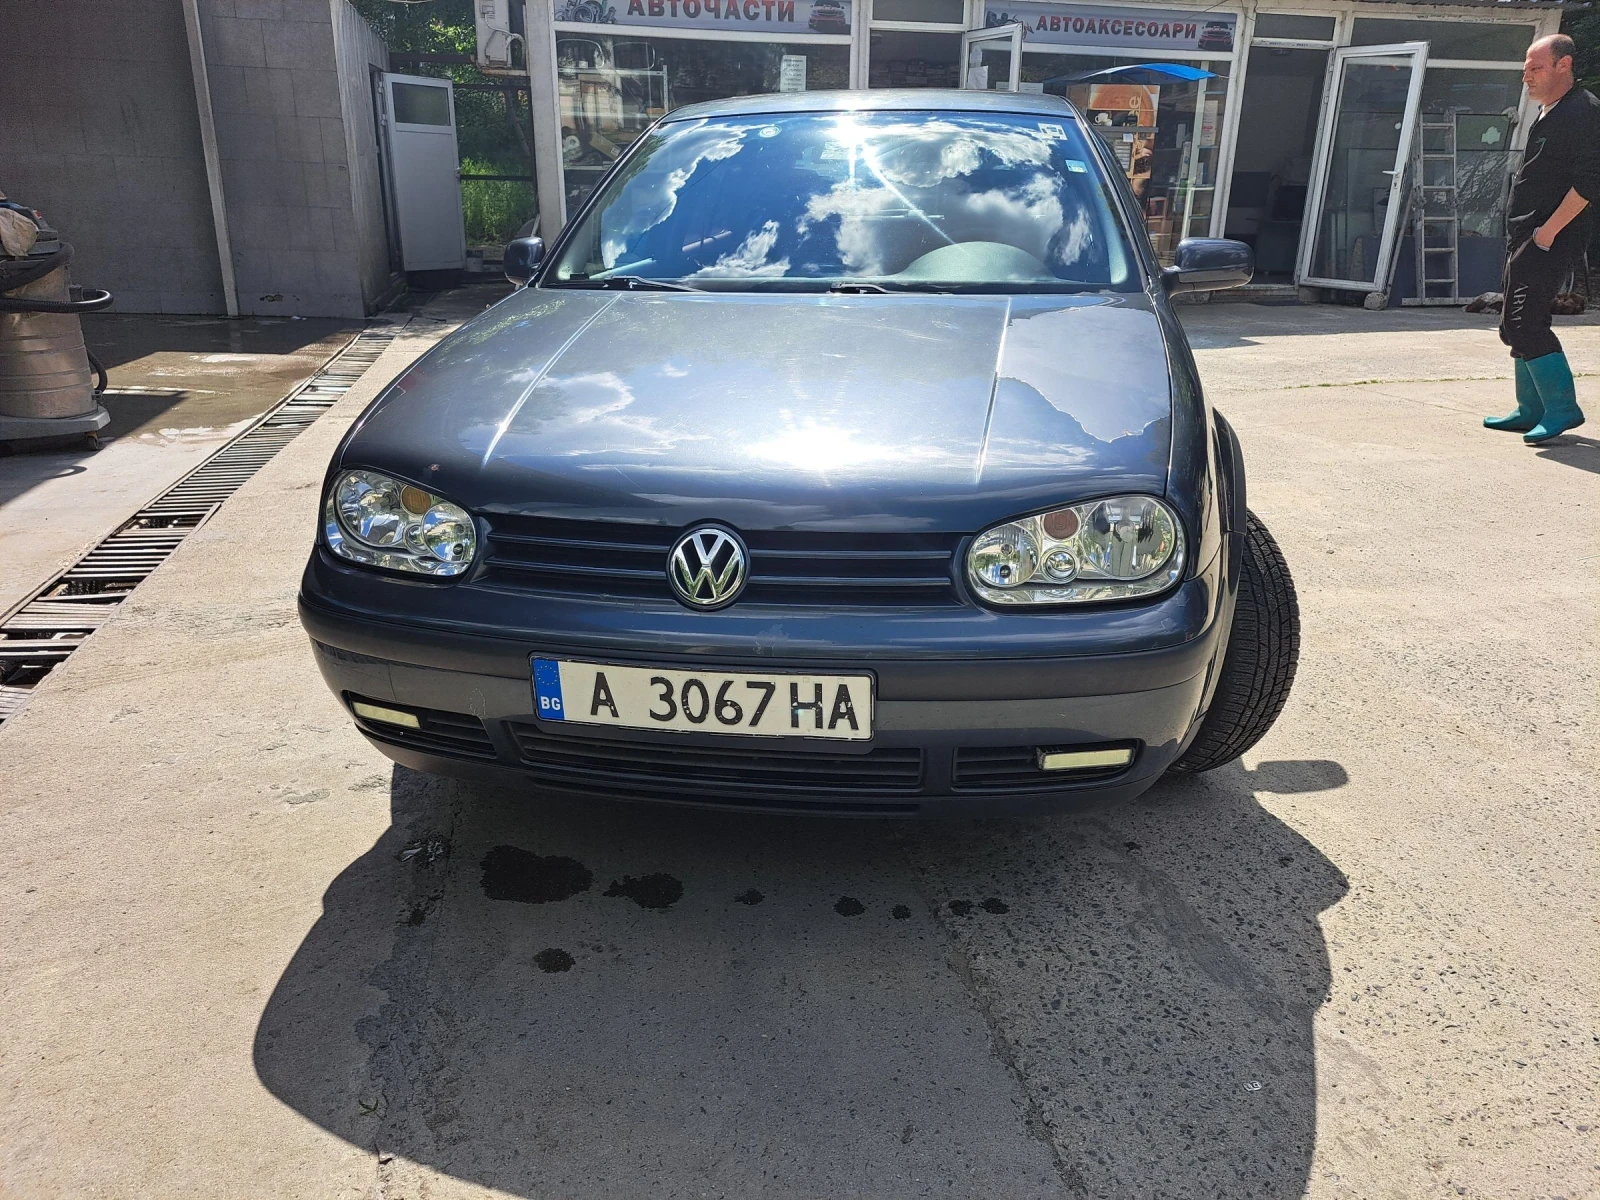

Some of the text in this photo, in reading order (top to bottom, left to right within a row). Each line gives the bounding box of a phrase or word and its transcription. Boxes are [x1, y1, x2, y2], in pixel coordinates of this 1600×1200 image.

[627, 0, 795, 22] АВТОЧАСТИ
[1036, 15, 1197, 39] АВТОАКСЕСОАРИ
[1511, 283, 1529, 329] ARM
[540, 695, 561, 711] BG
[649, 676, 776, 728] 3067
